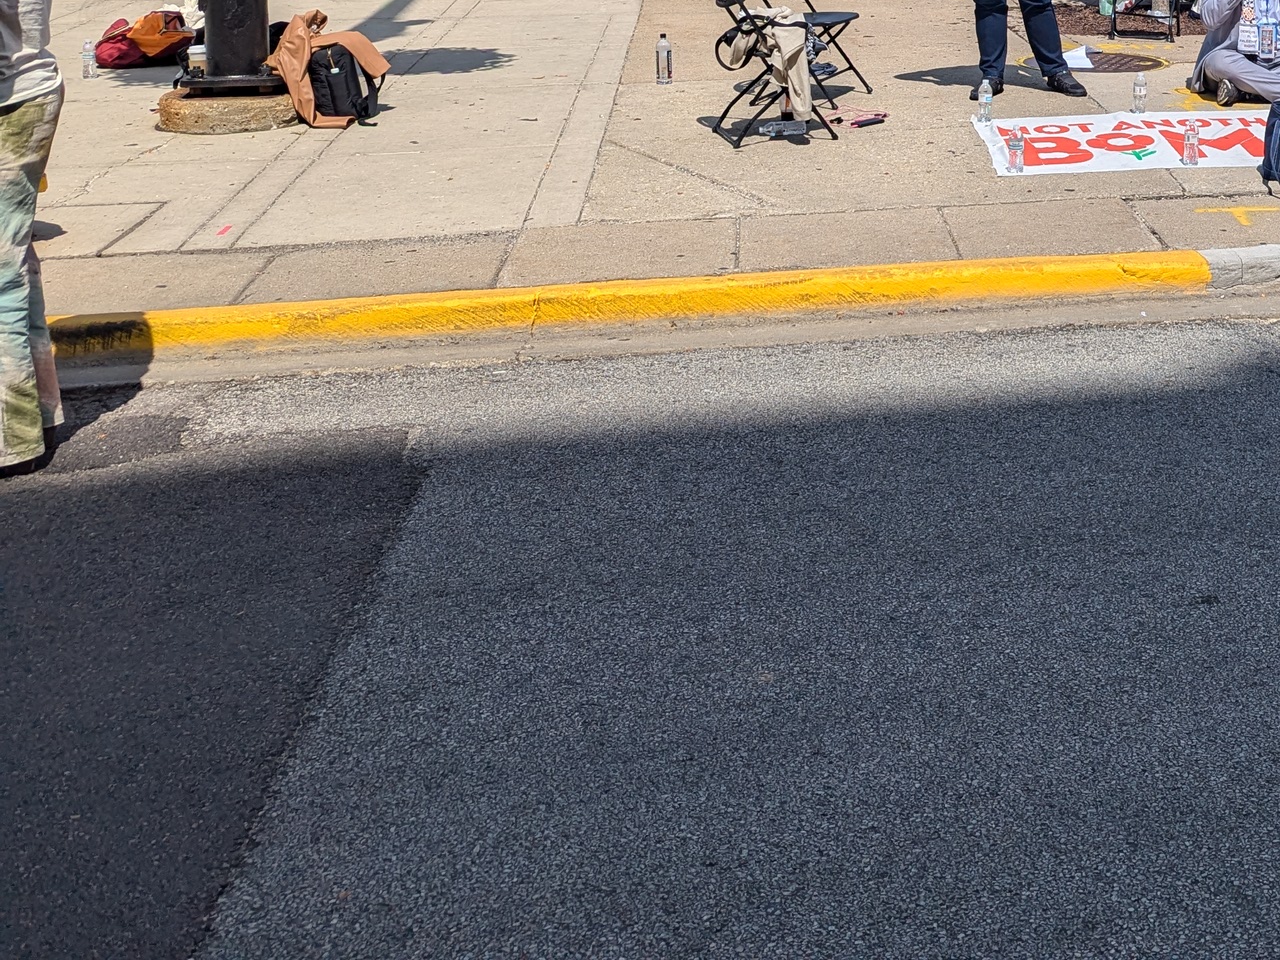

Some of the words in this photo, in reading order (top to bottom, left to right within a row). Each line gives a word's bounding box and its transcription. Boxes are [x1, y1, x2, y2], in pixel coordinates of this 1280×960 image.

[997, 123, 1094, 137] NOT
[1111, 117, 1267, 131] ANOTH
[1003, 128, 1265, 167] BOM
